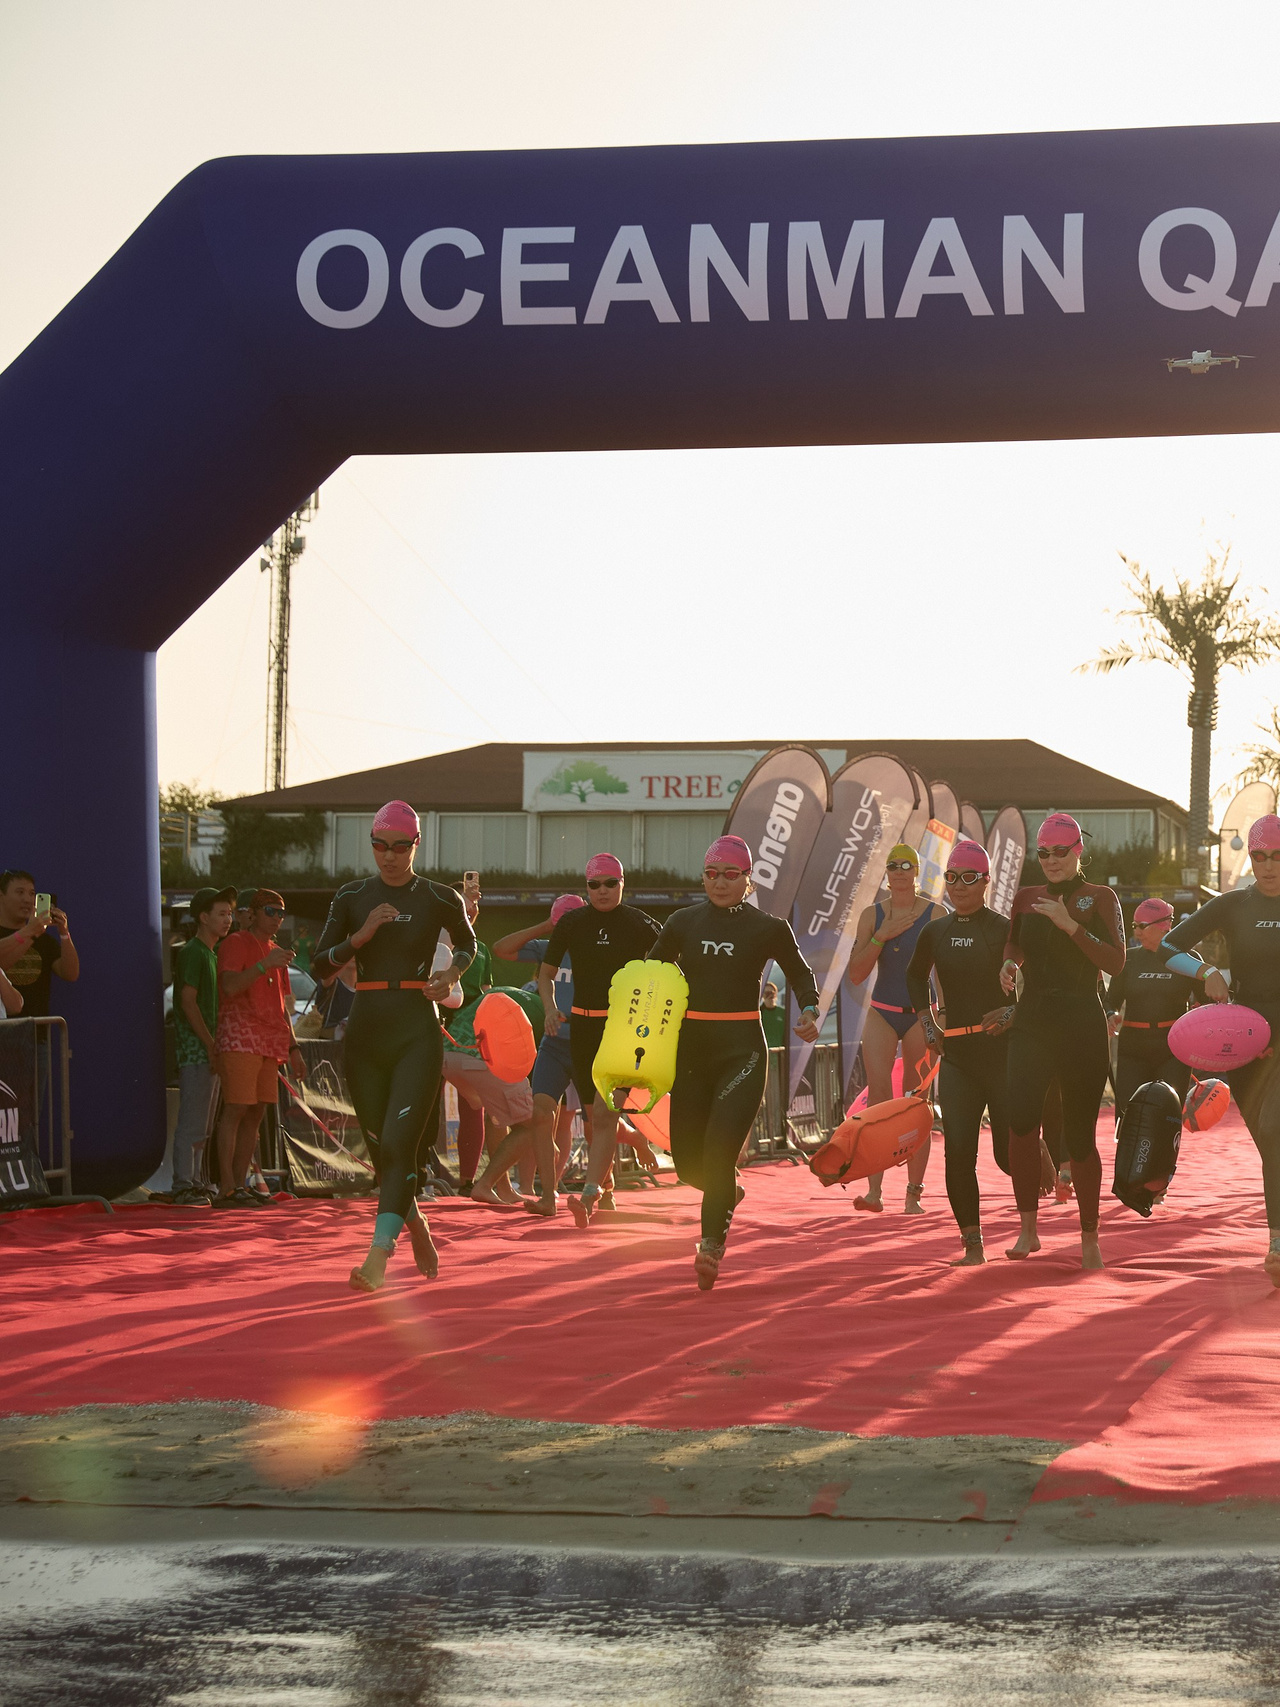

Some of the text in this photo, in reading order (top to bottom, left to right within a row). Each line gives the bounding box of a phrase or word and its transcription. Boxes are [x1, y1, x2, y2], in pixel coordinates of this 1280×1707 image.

[295, 211, 1086, 330] OCEANMAN
[640, 775, 723, 798] TREE
[701, 940, 735, 957] TYR
[629, 988, 641, 1014] 720
[661, 998, 673, 1025] 720
[718, 1051, 760, 1100] HURRICANE
[1137, 1140, 1151, 1164] 749
